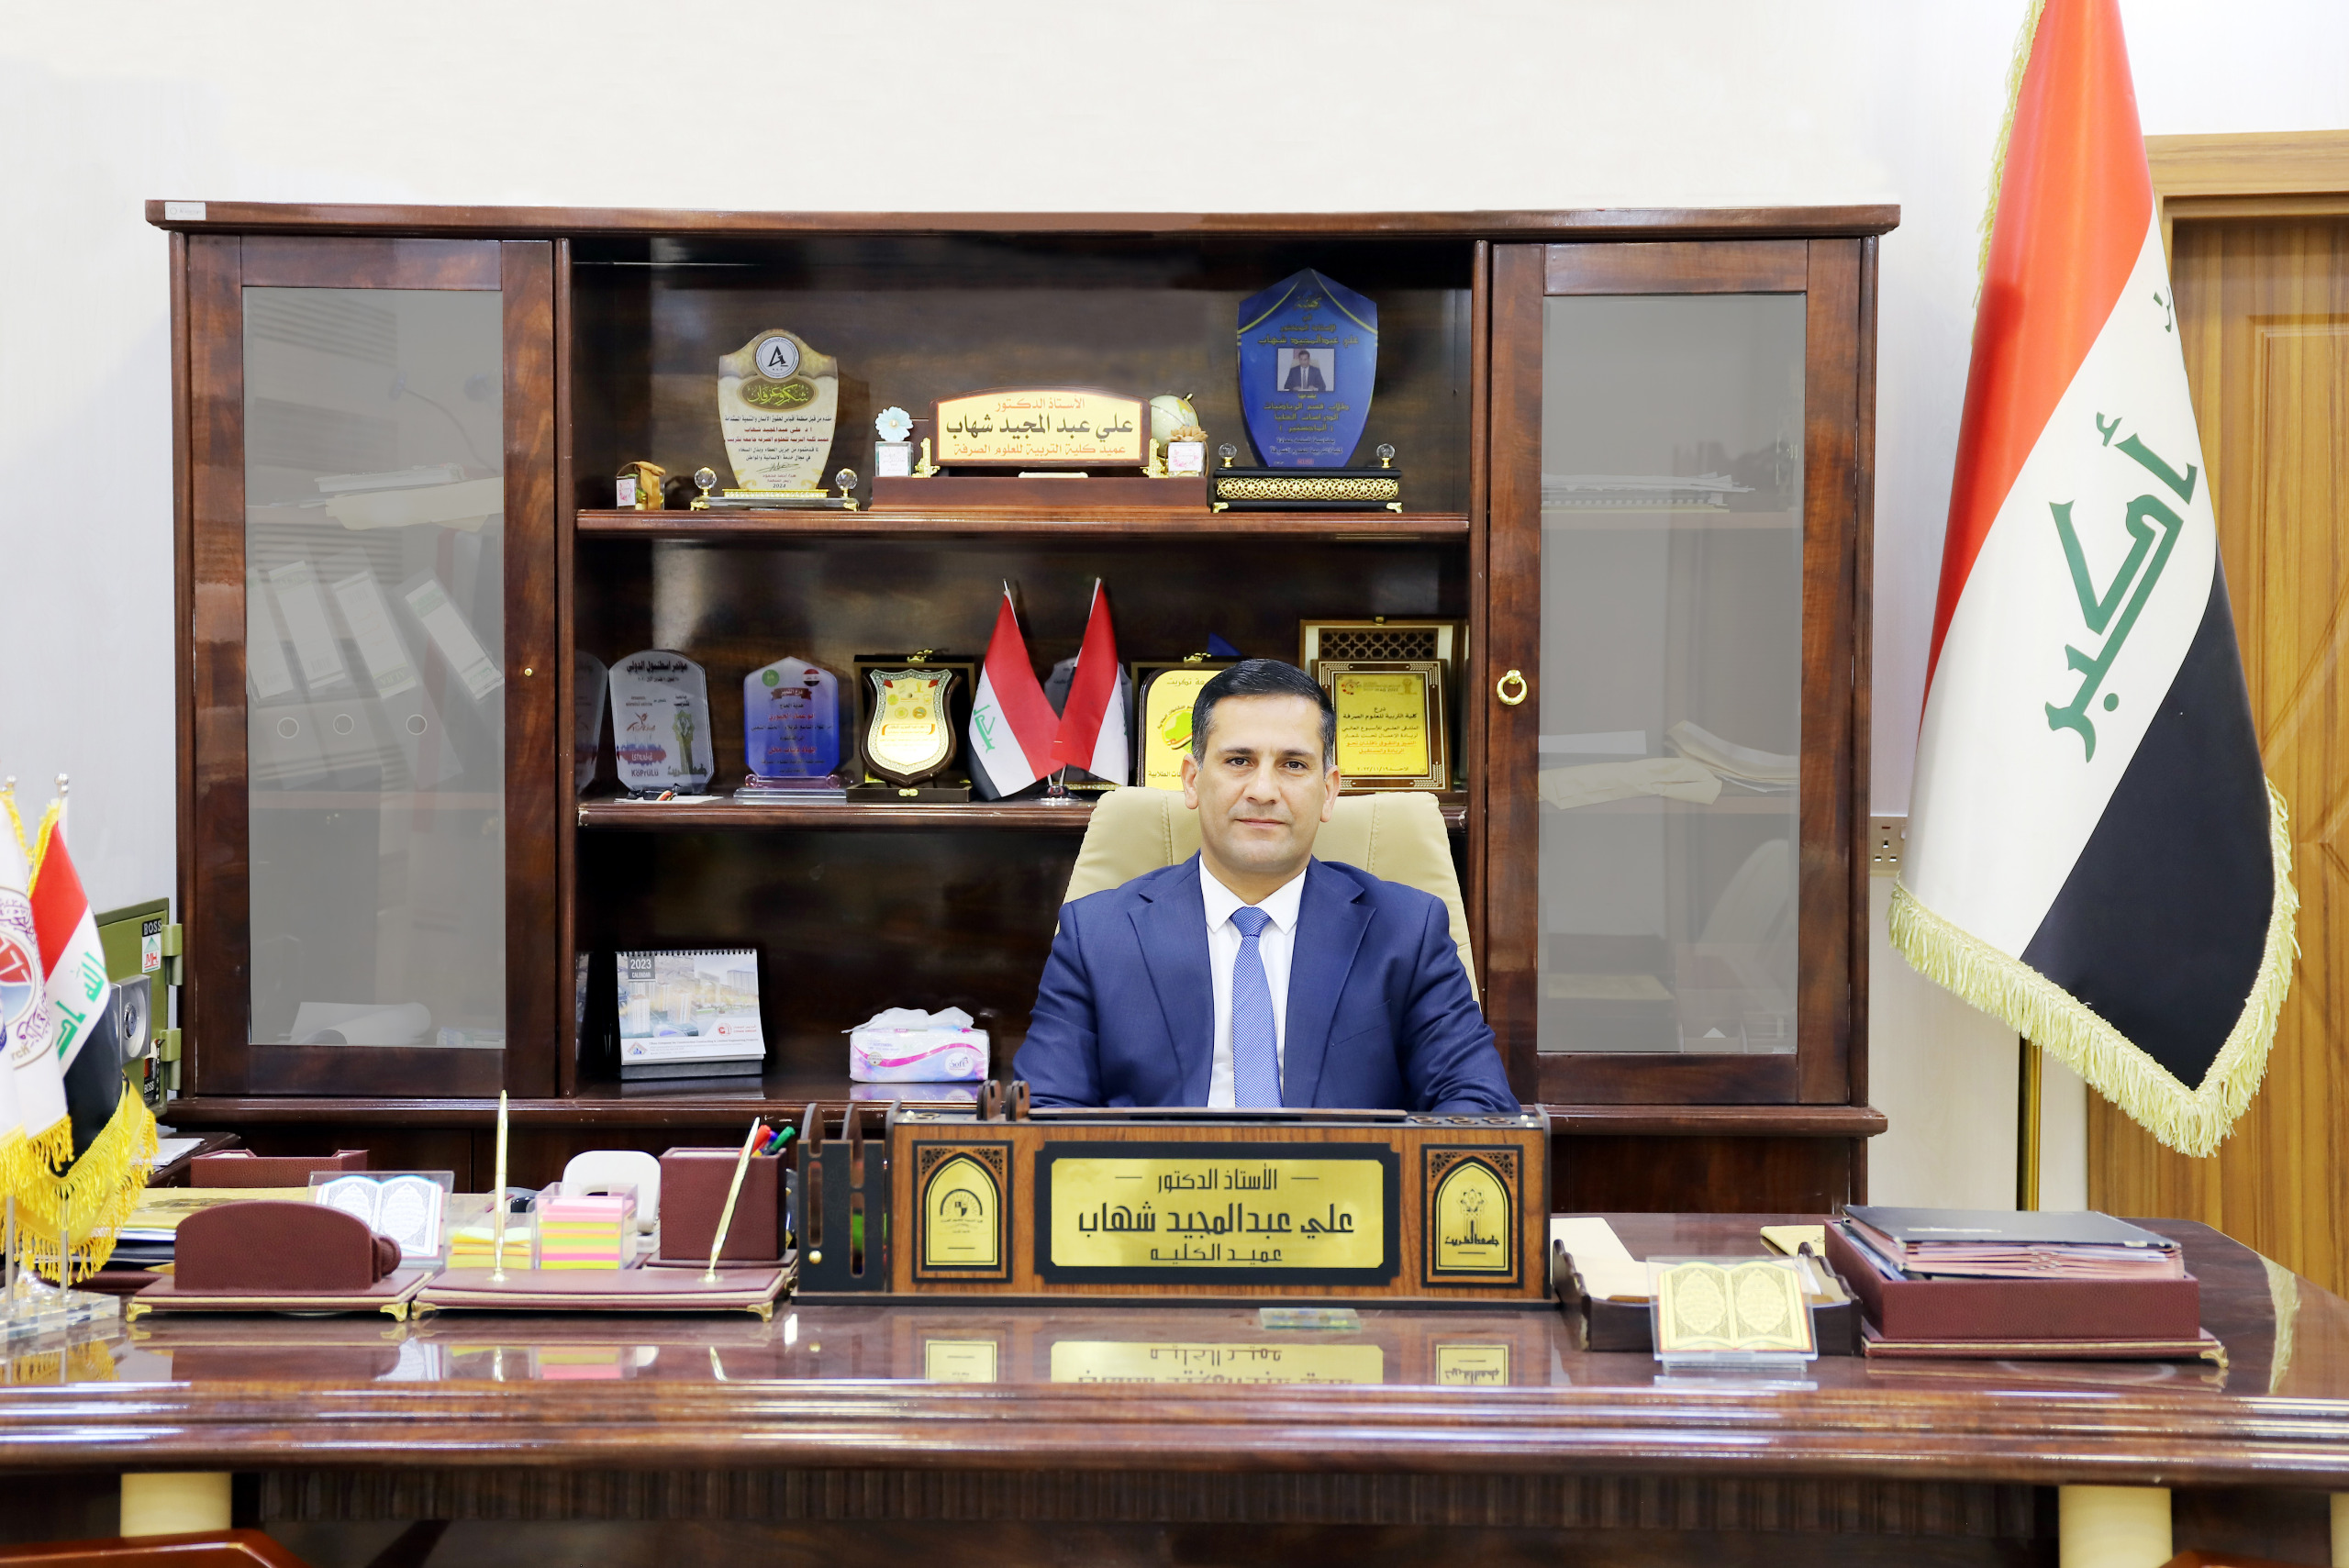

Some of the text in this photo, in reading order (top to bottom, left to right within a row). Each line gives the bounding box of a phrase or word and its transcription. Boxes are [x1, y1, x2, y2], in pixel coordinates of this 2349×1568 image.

[995, 398, 1046, 412] الدكتور
[946, 413, 994, 439] شهاب
[1096, 413, 1134, 442] علي
[953, 443, 1126, 456] عميد كلية التربية للعلوم الصرفة
[143, 919, 161, 936] BOSS
[630, 959, 651, 970] 2023
[144, 1081, 154, 1094] BOSS
[1158, 1162, 1277, 1194] الأستاذ الدكتور
[1079, 1201, 1155, 1238] شهاب
[1300, 1203, 1354, 1239] علي
[1227, 1248, 1283, 1265] عميد
